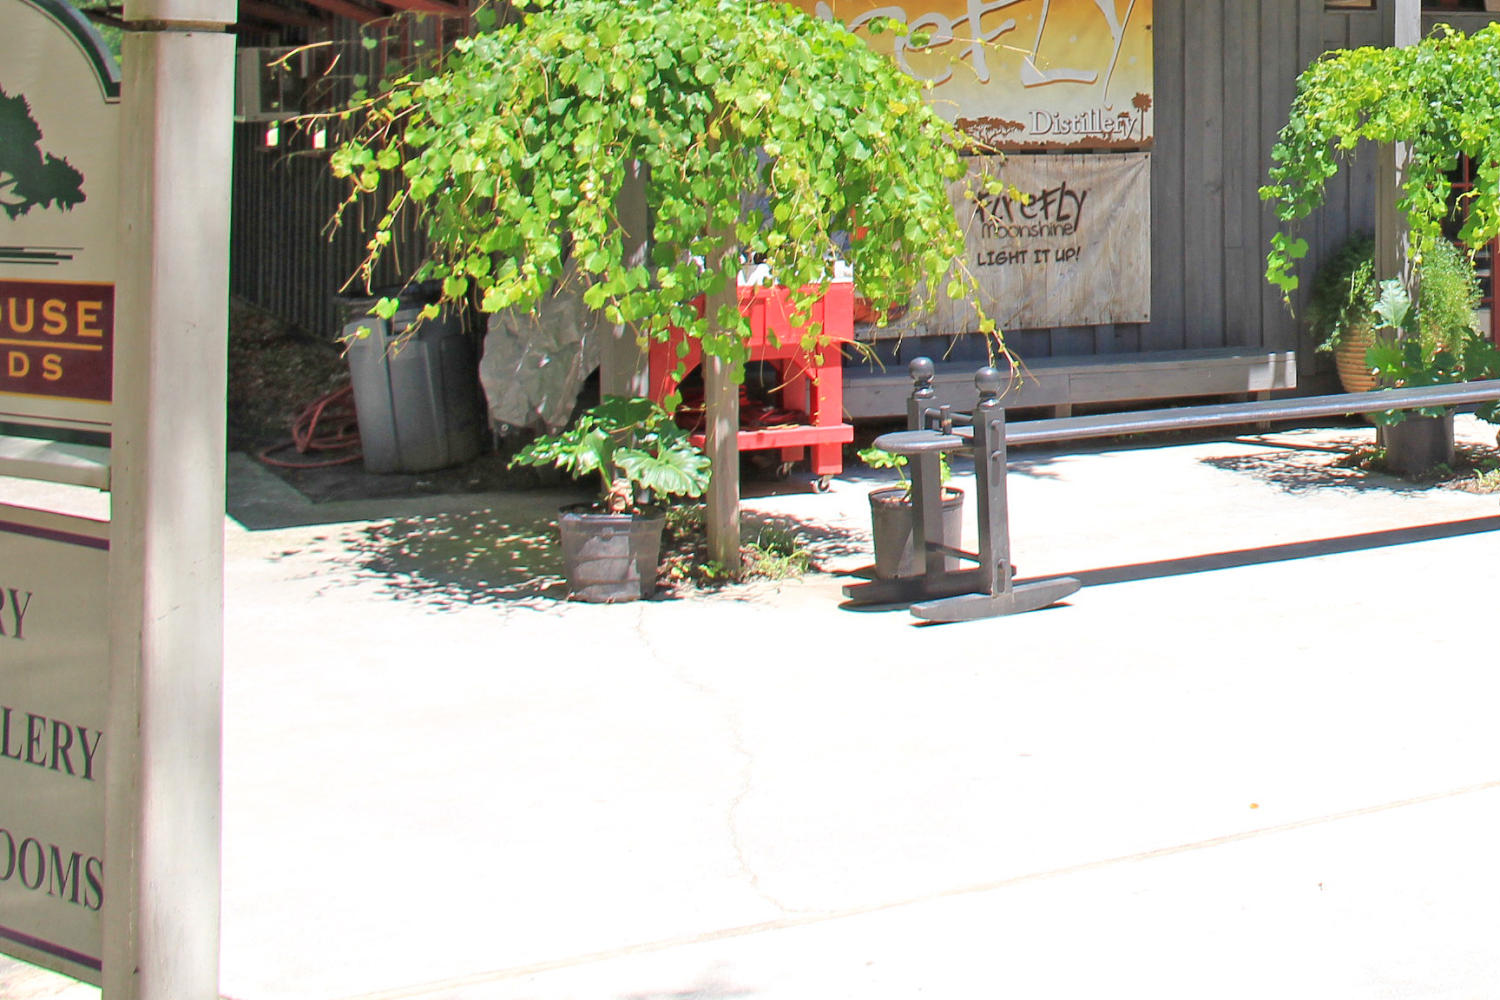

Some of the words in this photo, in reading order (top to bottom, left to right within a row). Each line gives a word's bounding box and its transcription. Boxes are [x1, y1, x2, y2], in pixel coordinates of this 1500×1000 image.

[1028, 108, 1139, 141] Distillery
[981, 221, 1074, 239] moonshine
[977, 250, 1029, 267] LIGHT
[1034, 249, 1051, 264] IT
[1055, 246, 1082, 263] UP!
[0, 297, 104, 338] USE
